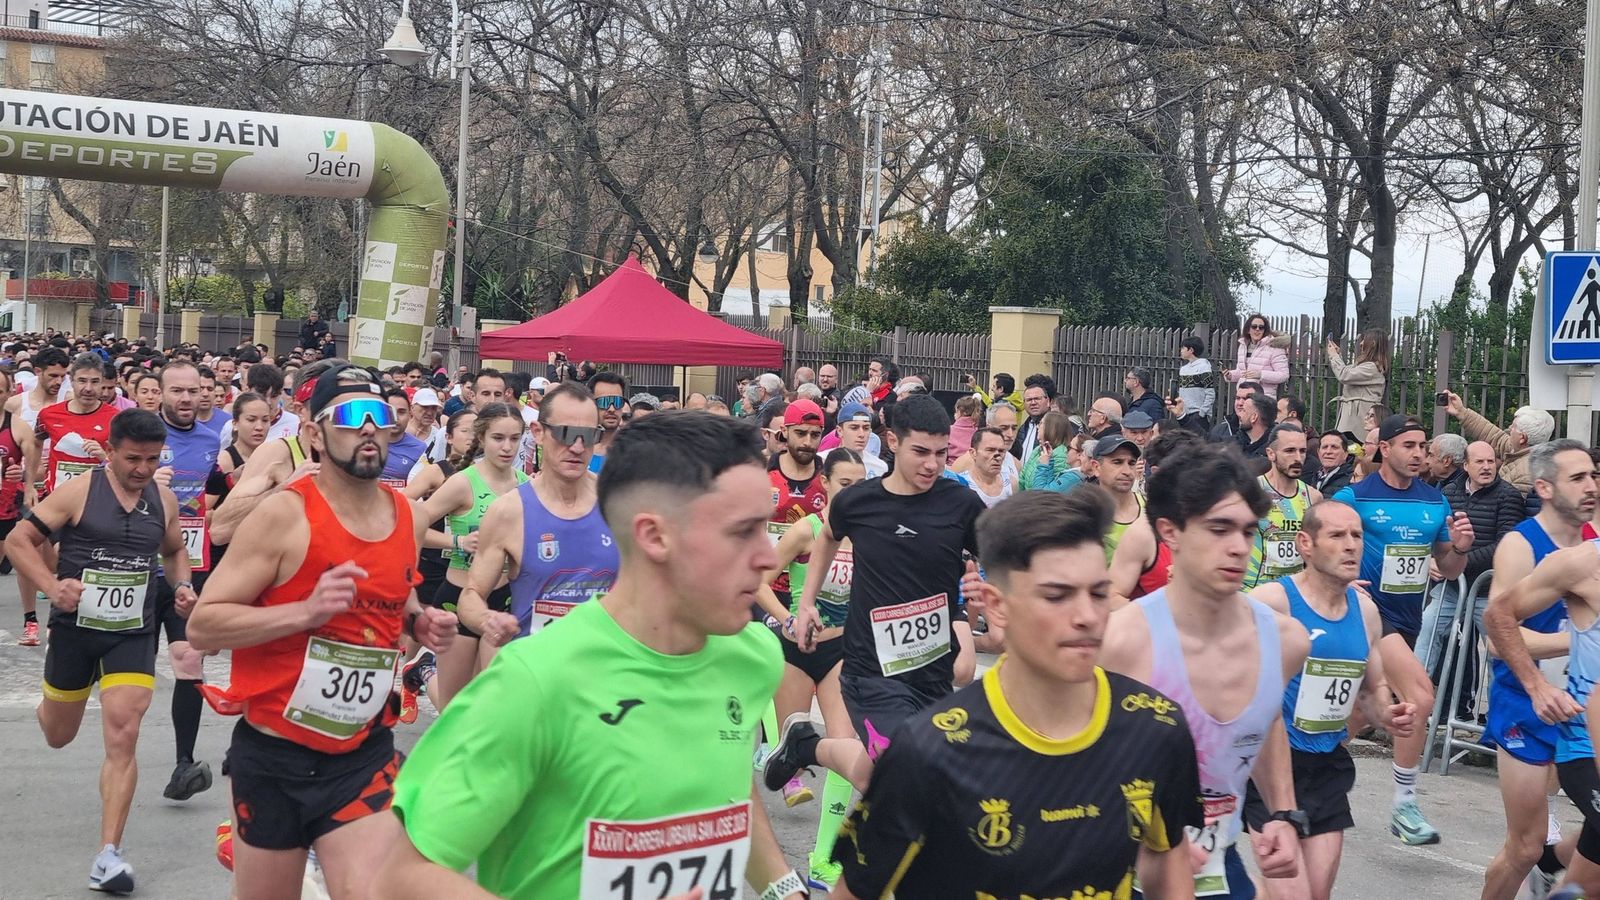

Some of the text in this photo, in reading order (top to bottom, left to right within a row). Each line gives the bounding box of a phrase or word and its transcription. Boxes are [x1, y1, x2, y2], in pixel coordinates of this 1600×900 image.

[0, 101, 279, 148] TACIÓN DE JAÉN
[305, 152, 360, 178] Jaén
[1396, 557, 1426, 575] 387
[96, 587, 135, 609] 706
[884, 612, 941, 646] 1289
[321, 666, 376, 704] 305
[1324, 678, 1352, 706] 48
[610, 848, 737, 900] 1274
